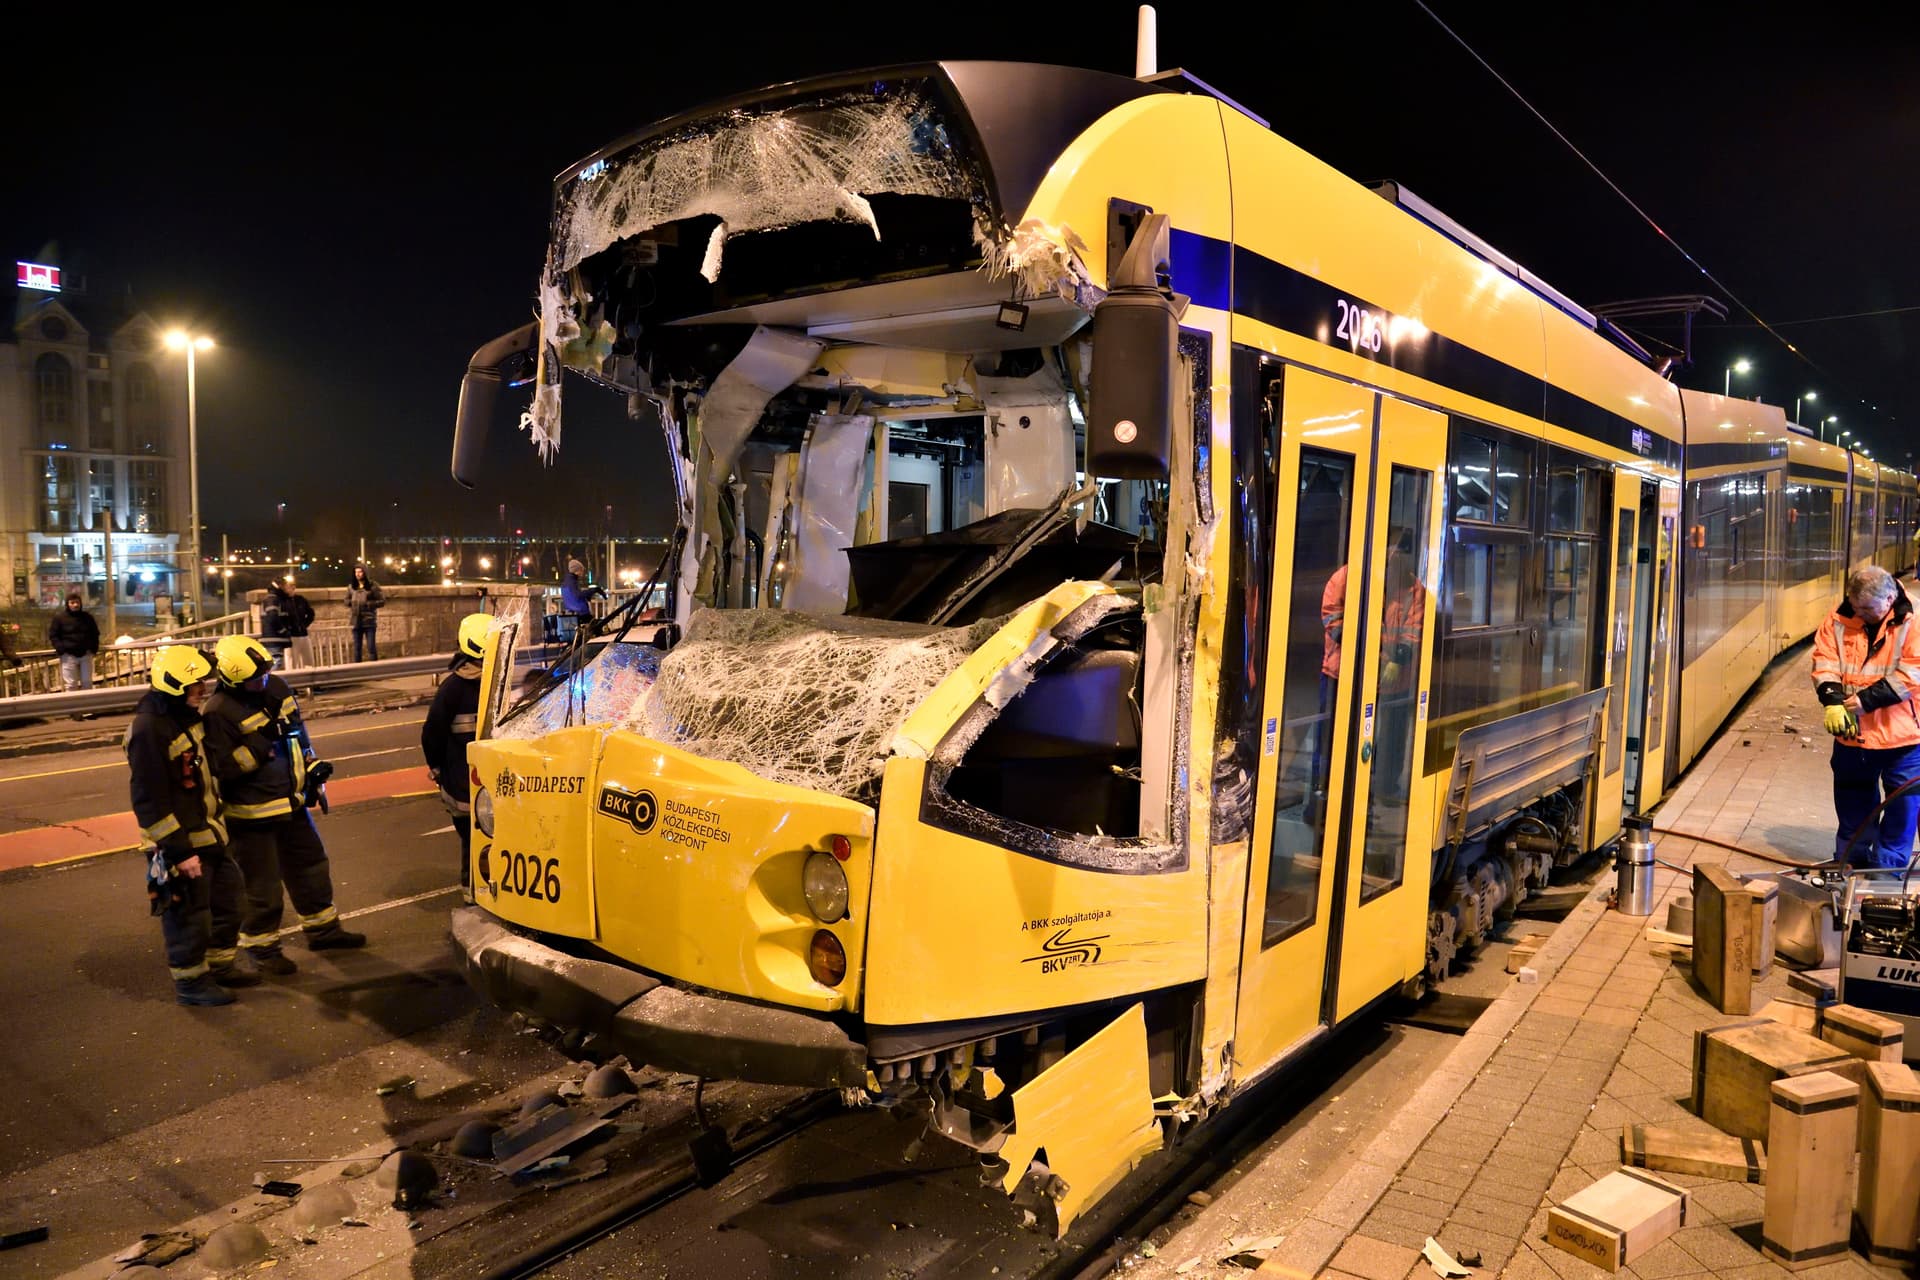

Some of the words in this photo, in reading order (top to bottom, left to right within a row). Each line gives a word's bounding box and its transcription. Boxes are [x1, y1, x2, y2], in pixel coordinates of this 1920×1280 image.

[1336, 299, 1381, 352] 2026
[518, 776, 585, 794] BUDAPEST
[605, 793, 631, 815] BKK
[665, 799, 721, 825] BUDAPESTI
[660, 828, 708, 851] KÖZPONT
[662, 814, 731, 844] KÖZLEKEDÉSI
[500, 849, 560, 904] 2026
[1021, 921, 1029, 932] A
[1031, 918, 1049, 930] BKK
[1051, 909, 1104, 927] szolgáltatója
[1105, 909, 1112, 918] a
[1876, 965, 1920, 984] LUK
